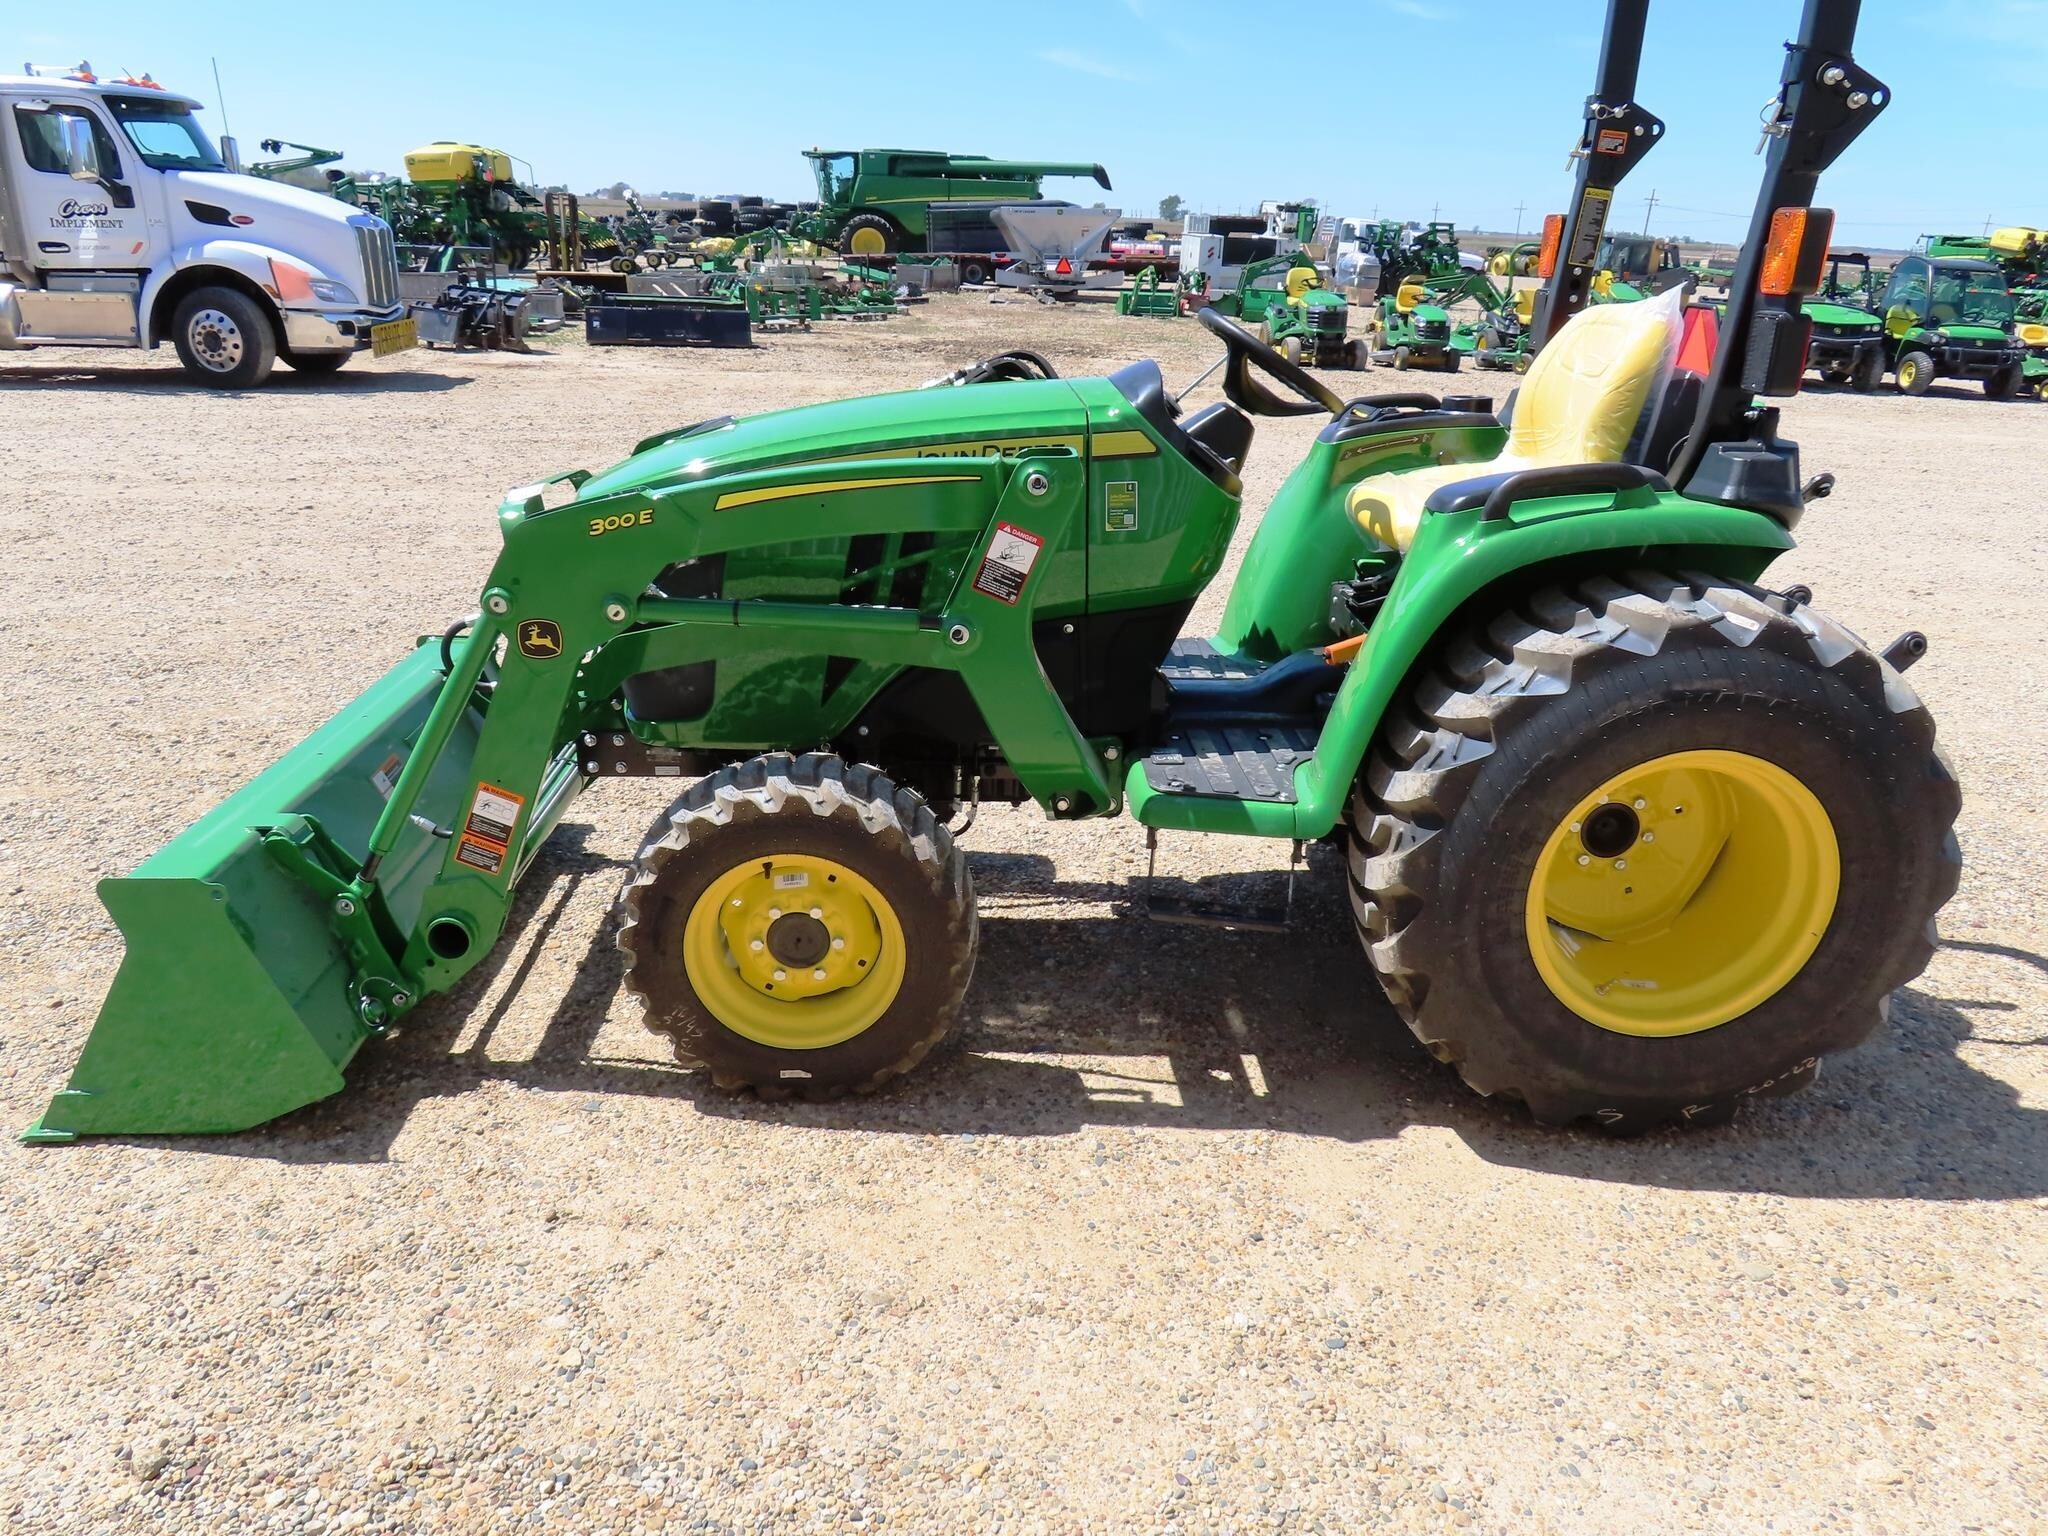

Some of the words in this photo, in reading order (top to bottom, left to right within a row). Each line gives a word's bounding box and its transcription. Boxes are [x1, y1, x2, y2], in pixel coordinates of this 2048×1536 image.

[58, 199, 108, 218] Cross
[49, 217, 124, 229] IMPLEMENT
[1011, 528, 1038, 544] DANGER
